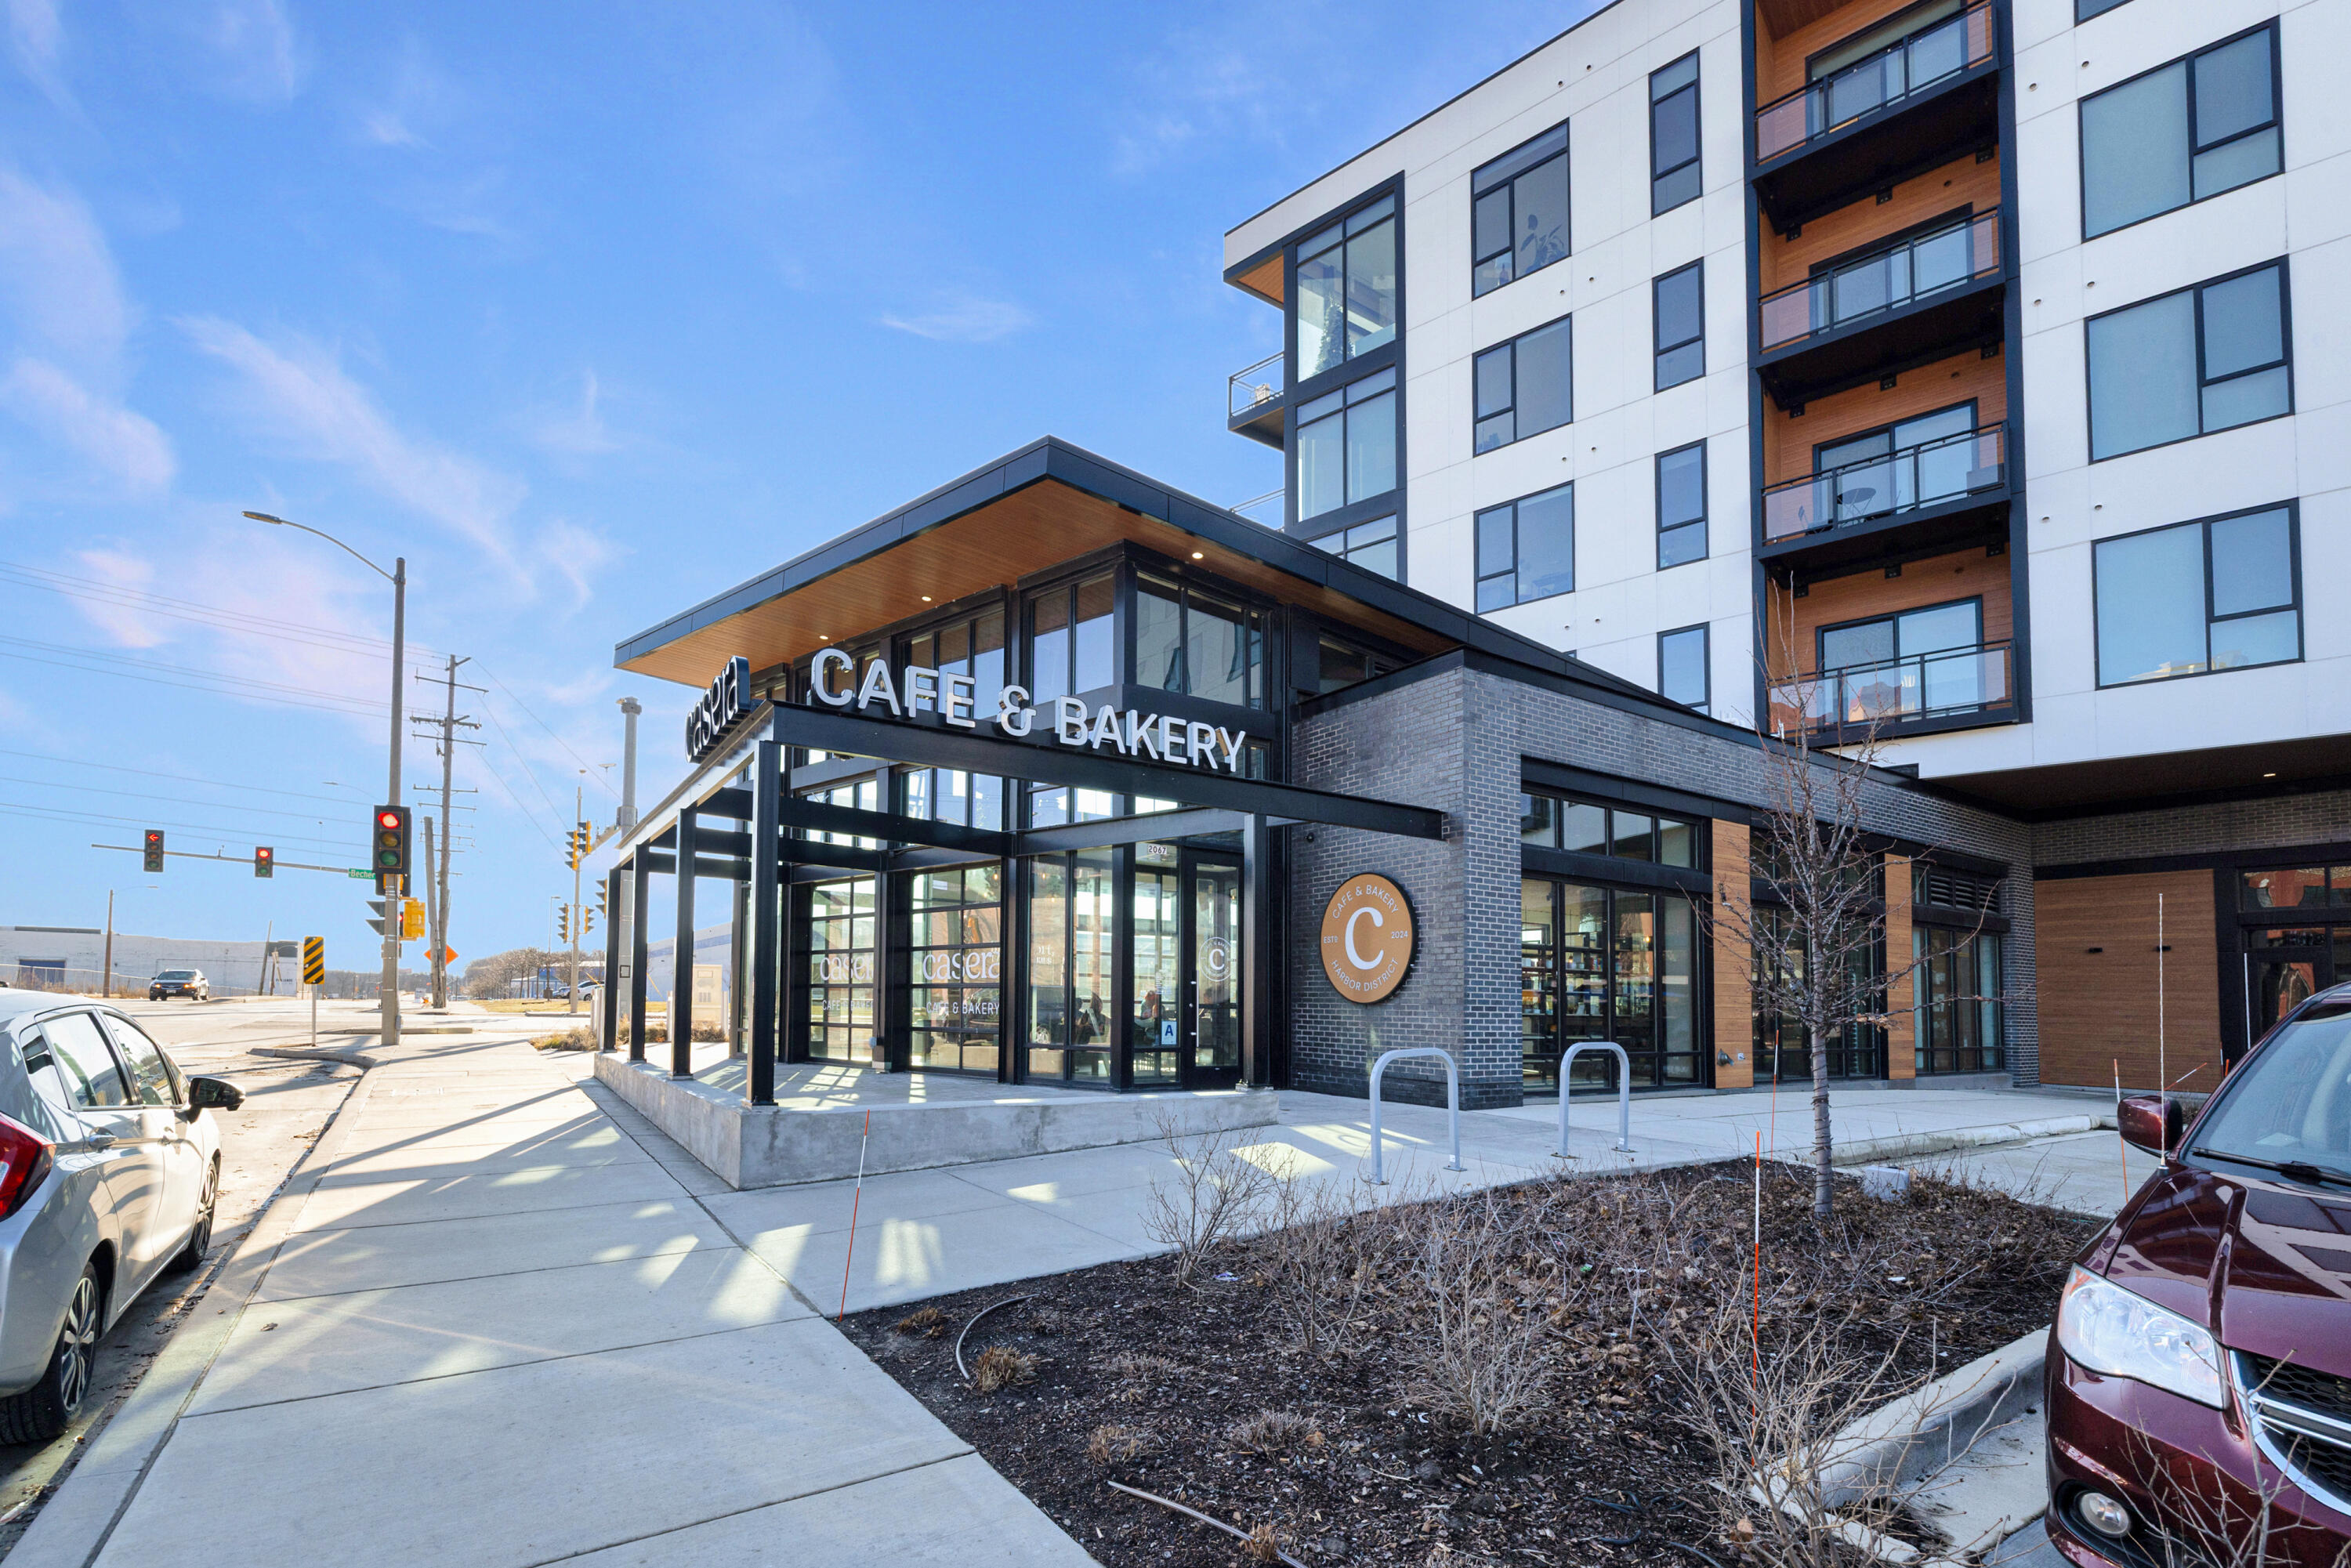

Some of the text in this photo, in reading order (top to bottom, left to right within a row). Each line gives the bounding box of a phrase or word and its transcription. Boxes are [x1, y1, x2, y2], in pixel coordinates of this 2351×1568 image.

[685, 655, 740, 763] casera
[810, 647, 1247, 773] CAFE & BAKERY
[1148, 845, 1167, 854] 2067
[350, 869, 376, 878] Becher
[1331, 884, 1399, 919] CAFE & BAKERY
[1345, 907, 1384, 970] C
[1391, 930, 1409, 940] 2024
[820, 956, 874, 981] caser
[1331, 956, 1400, 992] HARBOR DISTRICT
[962, 1001, 1000, 1016] BAKERY
[1165, 1024, 1174, 1037] A
